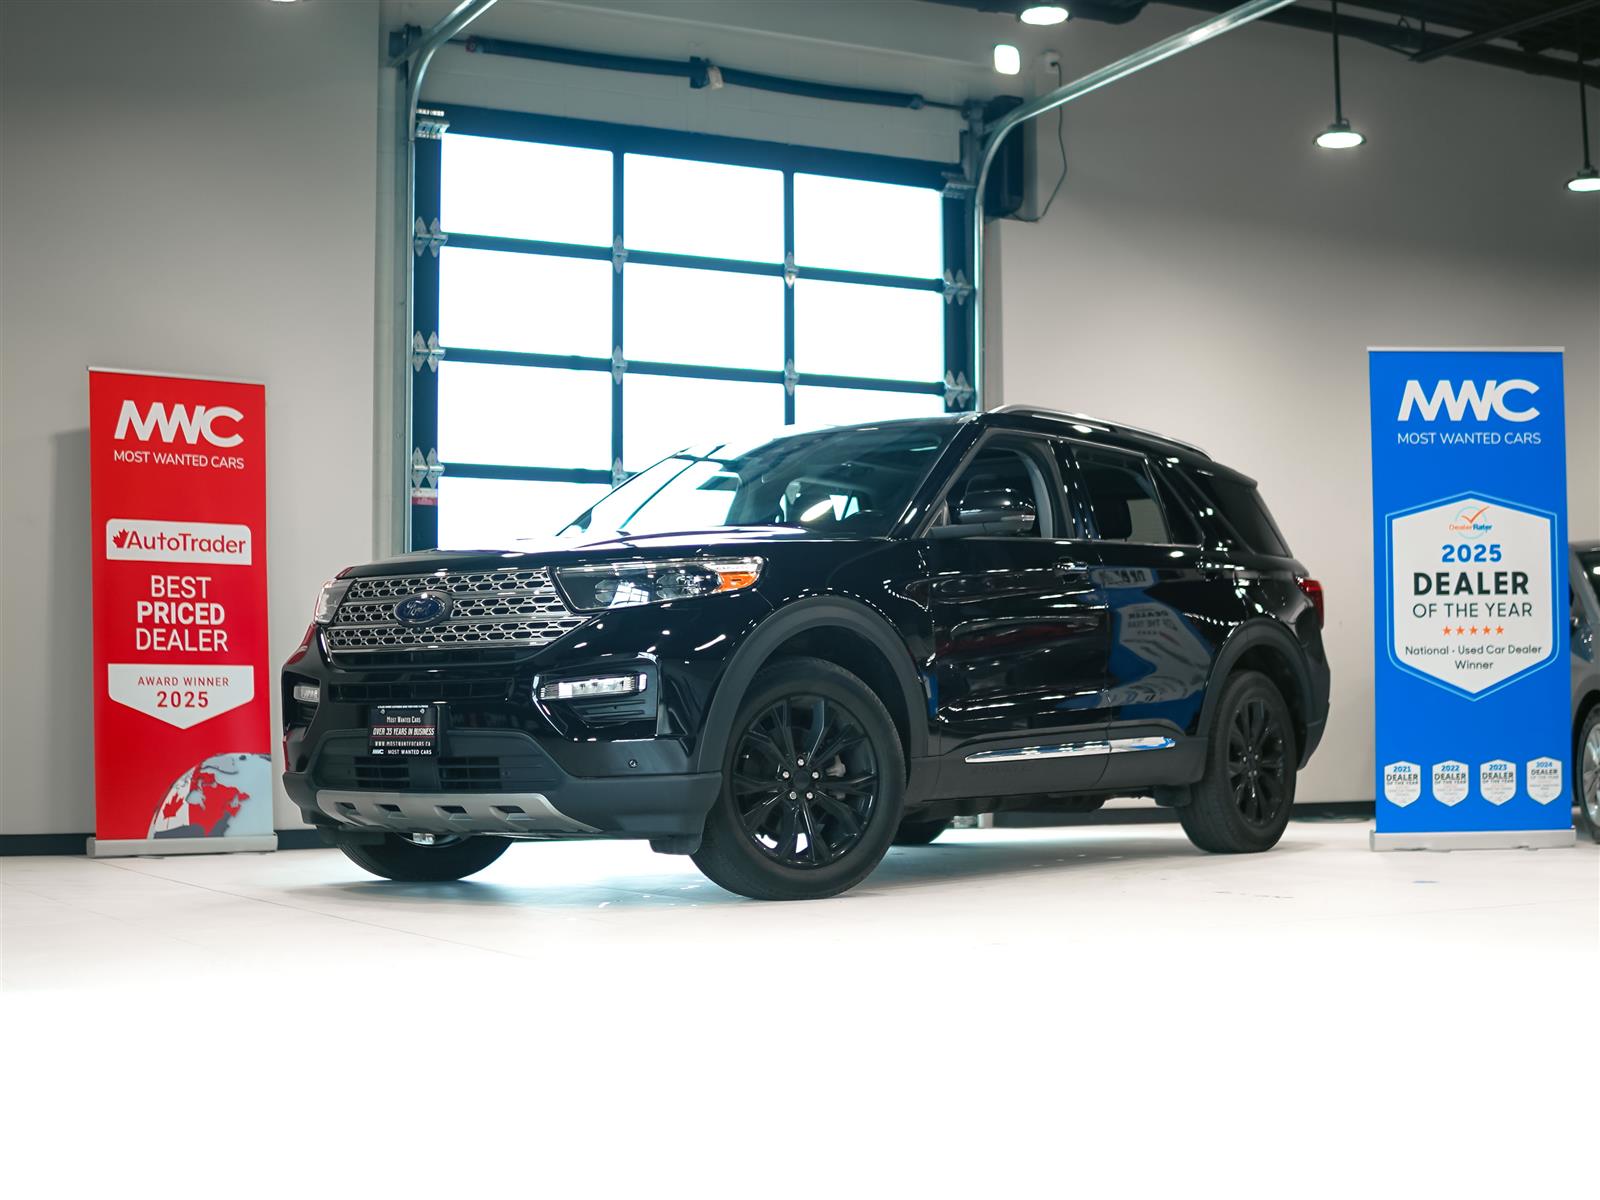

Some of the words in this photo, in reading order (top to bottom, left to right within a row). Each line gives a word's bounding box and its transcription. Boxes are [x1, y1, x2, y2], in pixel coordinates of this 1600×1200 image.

[1397, 379, 1540, 422] MWC
[114, 400, 244, 448] MWC
[1397, 432, 1436, 445] MOST
[1440, 432, 1500, 445] WANTED
[1504, 432, 1541, 445] CARS
[114, 450, 150, 463] MOST
[153, 452, 208, 467] WANTED
[211, 455, 245, 469] CARS
[126, 530, 246, 554] AutoTrader
[1441, 544, 1502, 562] 2025
[151, 575, 211, 598] BEST
[1413, 572, 1529, 595] DEALER
[137, 601, 225, 625] PRICED
[1413, 603, 1437, 618] OF
[1444, 603, 1478, 618] THE
[1484, 602, 1533, 617] YEAR
[136, 628, 228, 652] DEALER
[1405, 646, 1449, 656] National
[1458, 645, 1484, 655] Used
[1486, 645, 1505, 655] Car
[1508, 644, 1542, 655] Dealer
[1455, 660, 1494, 670] Winner
[138, 676, 179, 687] AWARD
[183, 677, 230, 687] WINNER
[157, 691, 209, 708] 2025
[373, 728, 386, 736] OVER
[393, 728, 407, 736] YEARS
[414, 728, 435, 736] BUSINESS
[1482, 772, 1514, 780] DEALER
